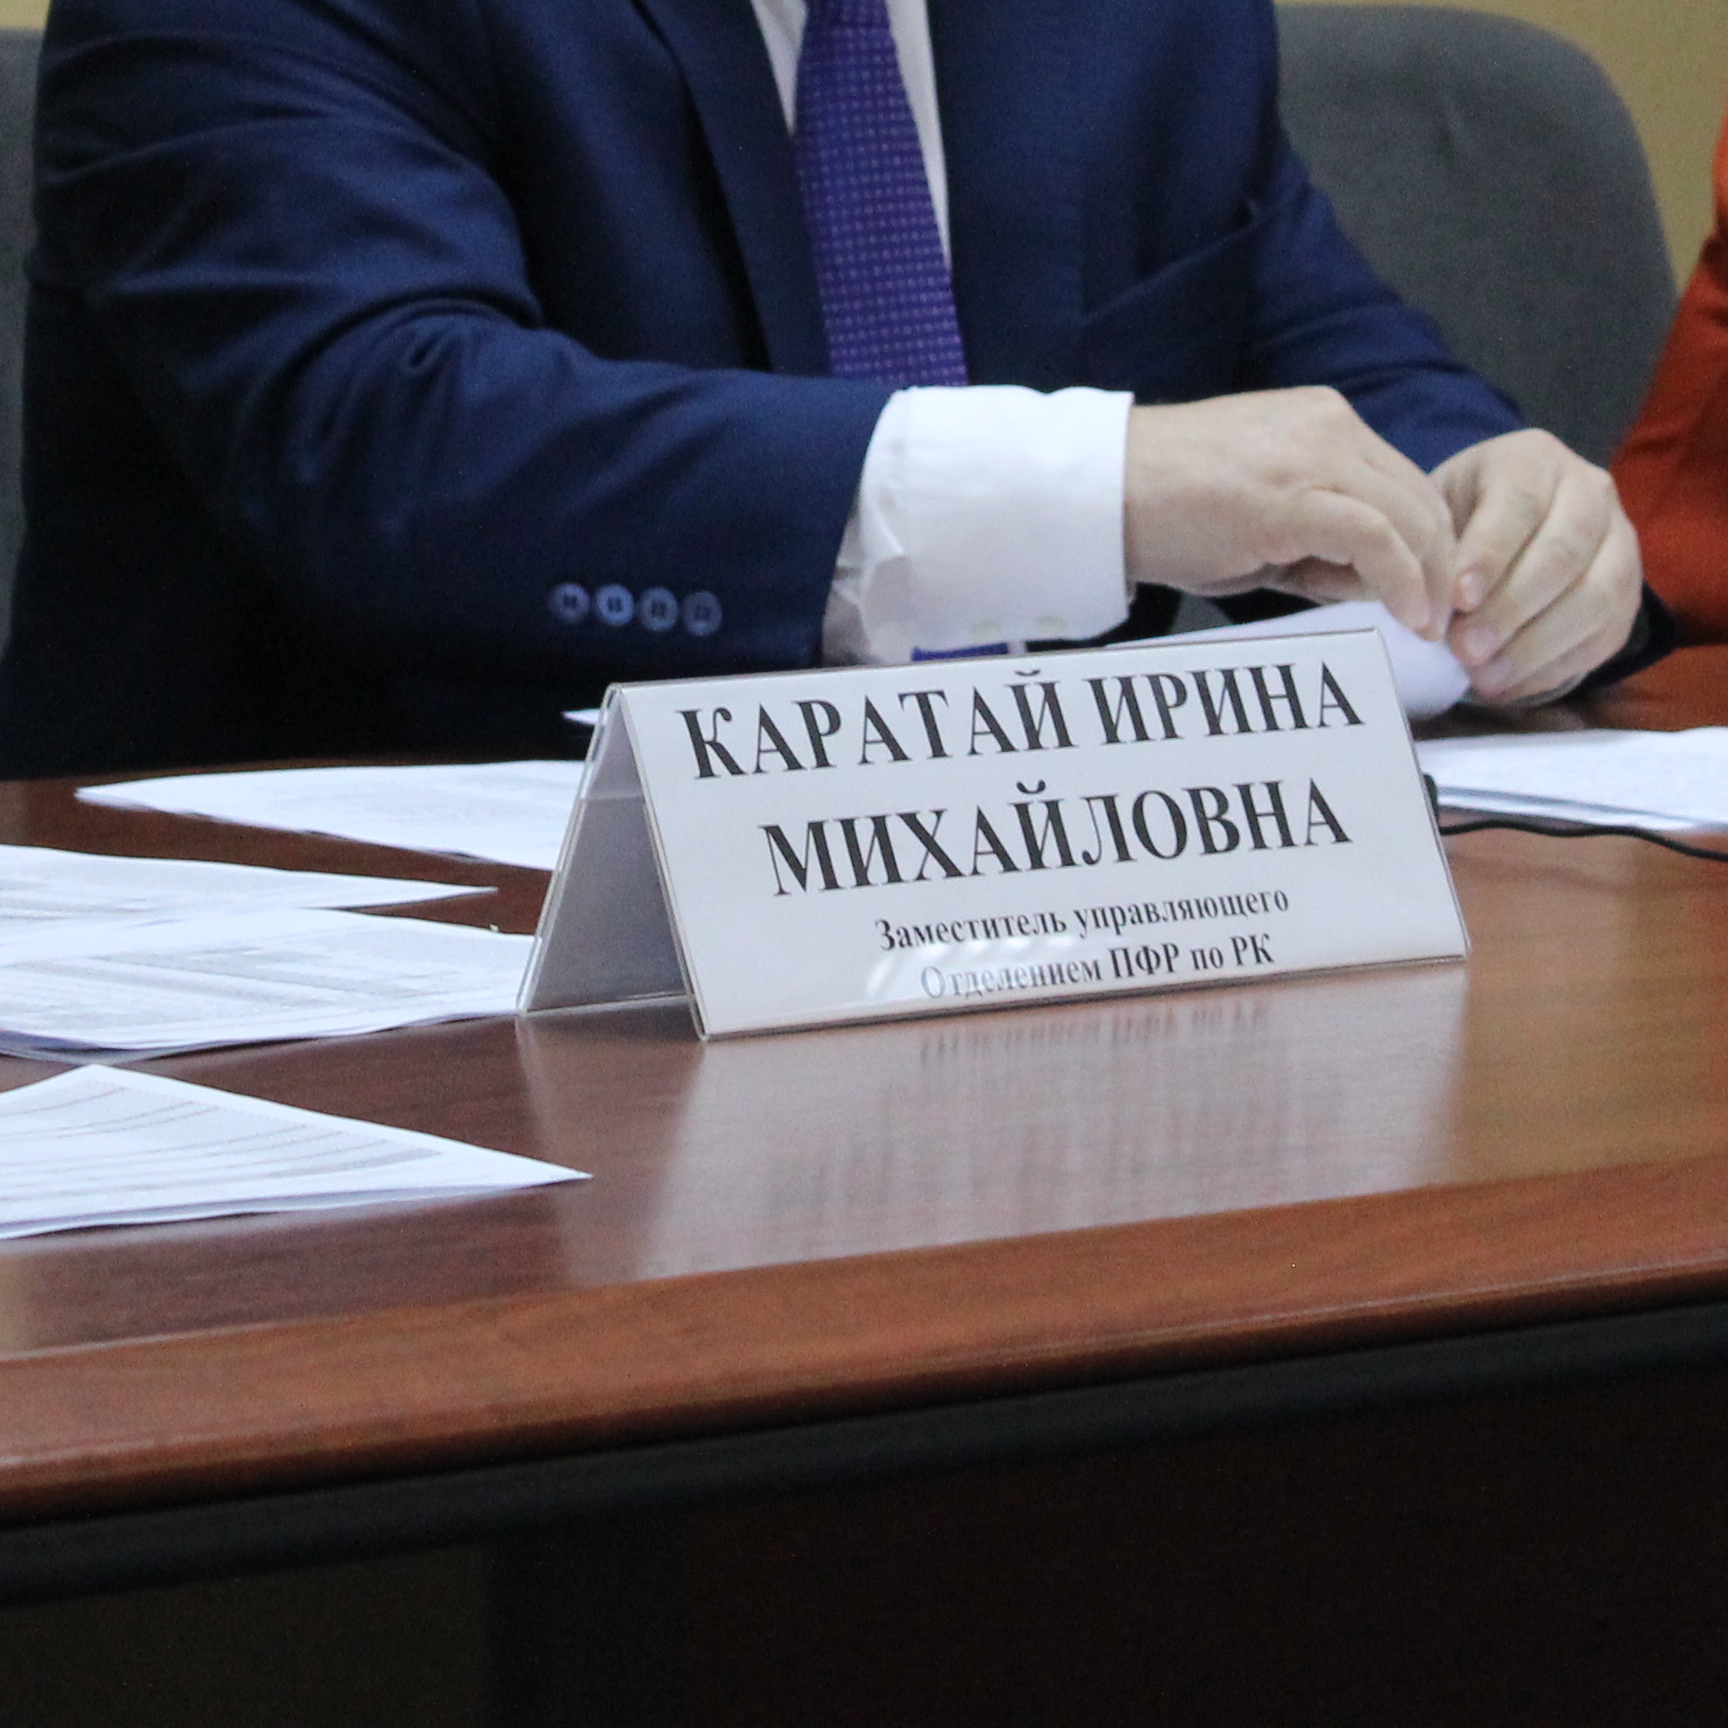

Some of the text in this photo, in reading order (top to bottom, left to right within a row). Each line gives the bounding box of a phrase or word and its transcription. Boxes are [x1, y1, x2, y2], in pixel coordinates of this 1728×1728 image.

[679, 660, 1365, 780] КАРАТАЙ ИРИНА
[759, 778, 1353, 897] МИХАЙЛОВНА
[874, 887, 1290, 952] Заместитель управляющего
[920, 931, 1276, 999] Отделением ПФР по РК
